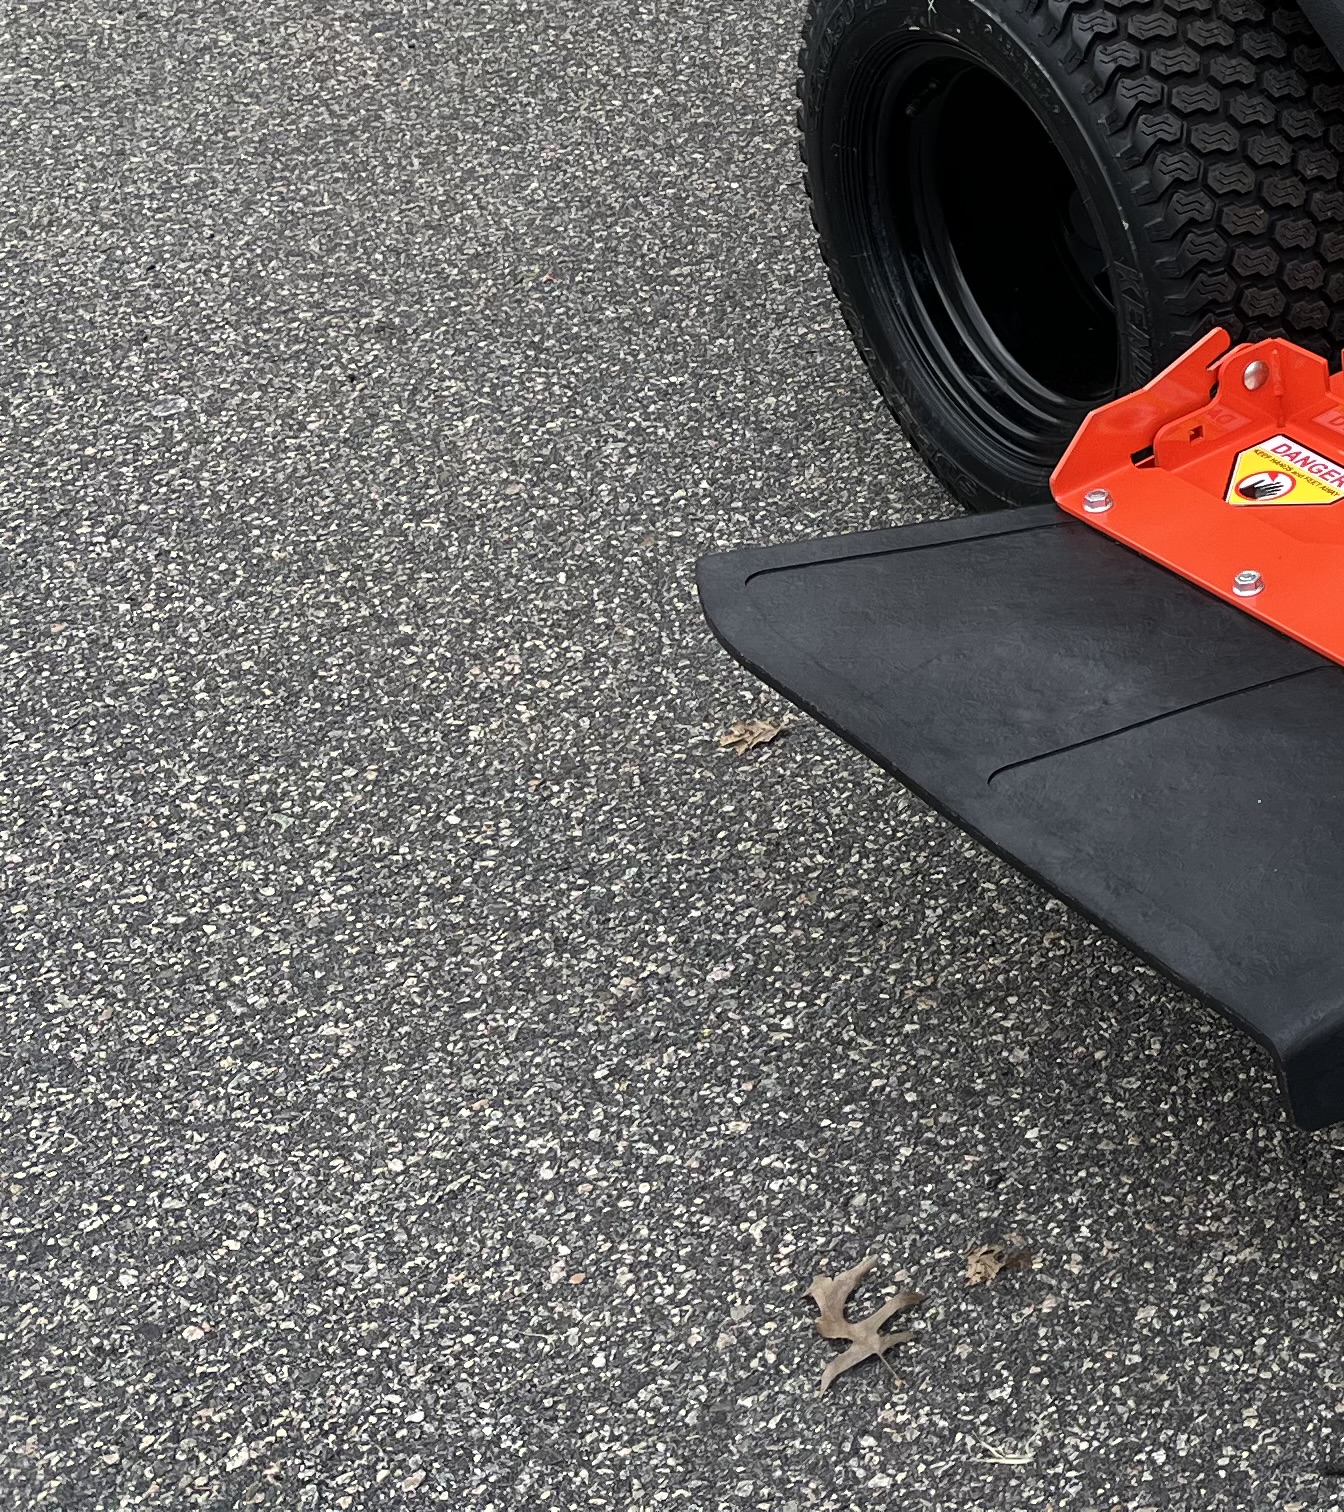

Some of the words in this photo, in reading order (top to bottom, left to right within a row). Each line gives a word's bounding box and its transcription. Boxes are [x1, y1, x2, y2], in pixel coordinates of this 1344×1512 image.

[1109, 259, 1155, 390] KEND
[1253, 448, 1269, 459] KEEP
[1270, 458, 1293, 472] HANDS
[1291, 470, 1305, 479] and
[1303, 476, 1322, 487] FEET
[1319, 484, 1341, 498] AWAY
